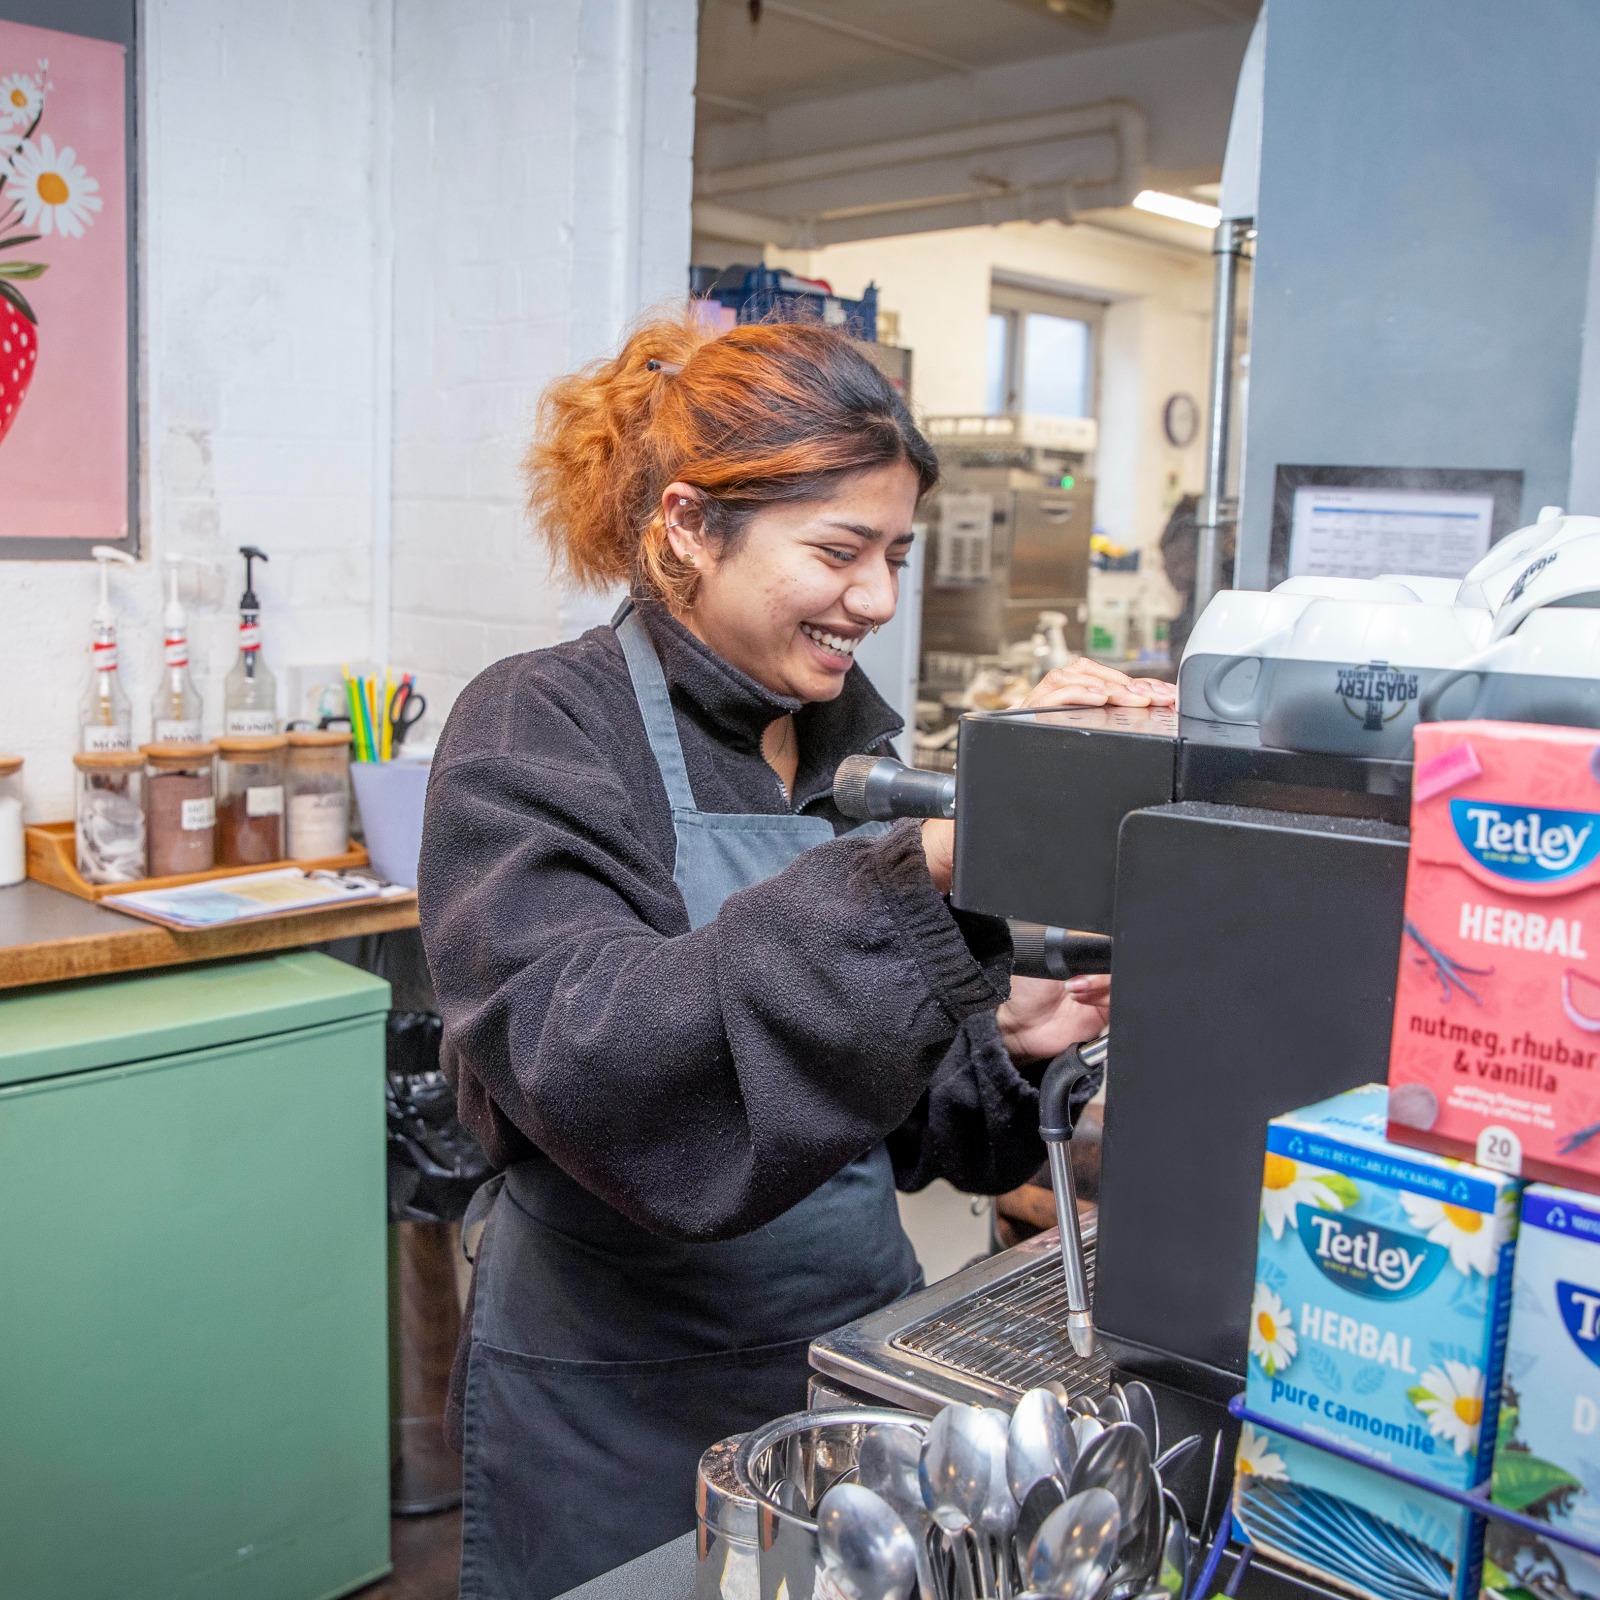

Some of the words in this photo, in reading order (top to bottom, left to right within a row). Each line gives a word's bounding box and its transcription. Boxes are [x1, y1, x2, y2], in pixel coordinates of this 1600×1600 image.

[1335, 679, 1418, 702] ROASTERY
[1337, 669, 1374, 681] BARISTA
[1377, 671, 1405, 683] BELLA
[1408, 674, 1419, 683] AT
[1366, 702, 1383, 715] THE
[93, 738, 132, 749] MONI
[1467, 808, 1592, 871] Tetley
[1459, 902, 1587, 960] HERBAL
[1410, 1014, 1506, 1058] nutmeg,
[1511, 1031, 1598, 1070] rhubar
[1453, 1049, 1470, 1074] &
[1476, 1059, 1557, 1094] vanilla
[1487, 1134, 1512, 1158] 20
[1332, 1149, 1389, 1178] RECYCLABLE
[1390, 1164, 1448, 1193] PACKAGING
[1311, 1215, 1426, 1291] Tetley
[1300, 1302, 1418, 1375] HERBAL
[1271, 1378, 1320, 1412] pure
[1323, 1399, 1436, 1456] camomile
